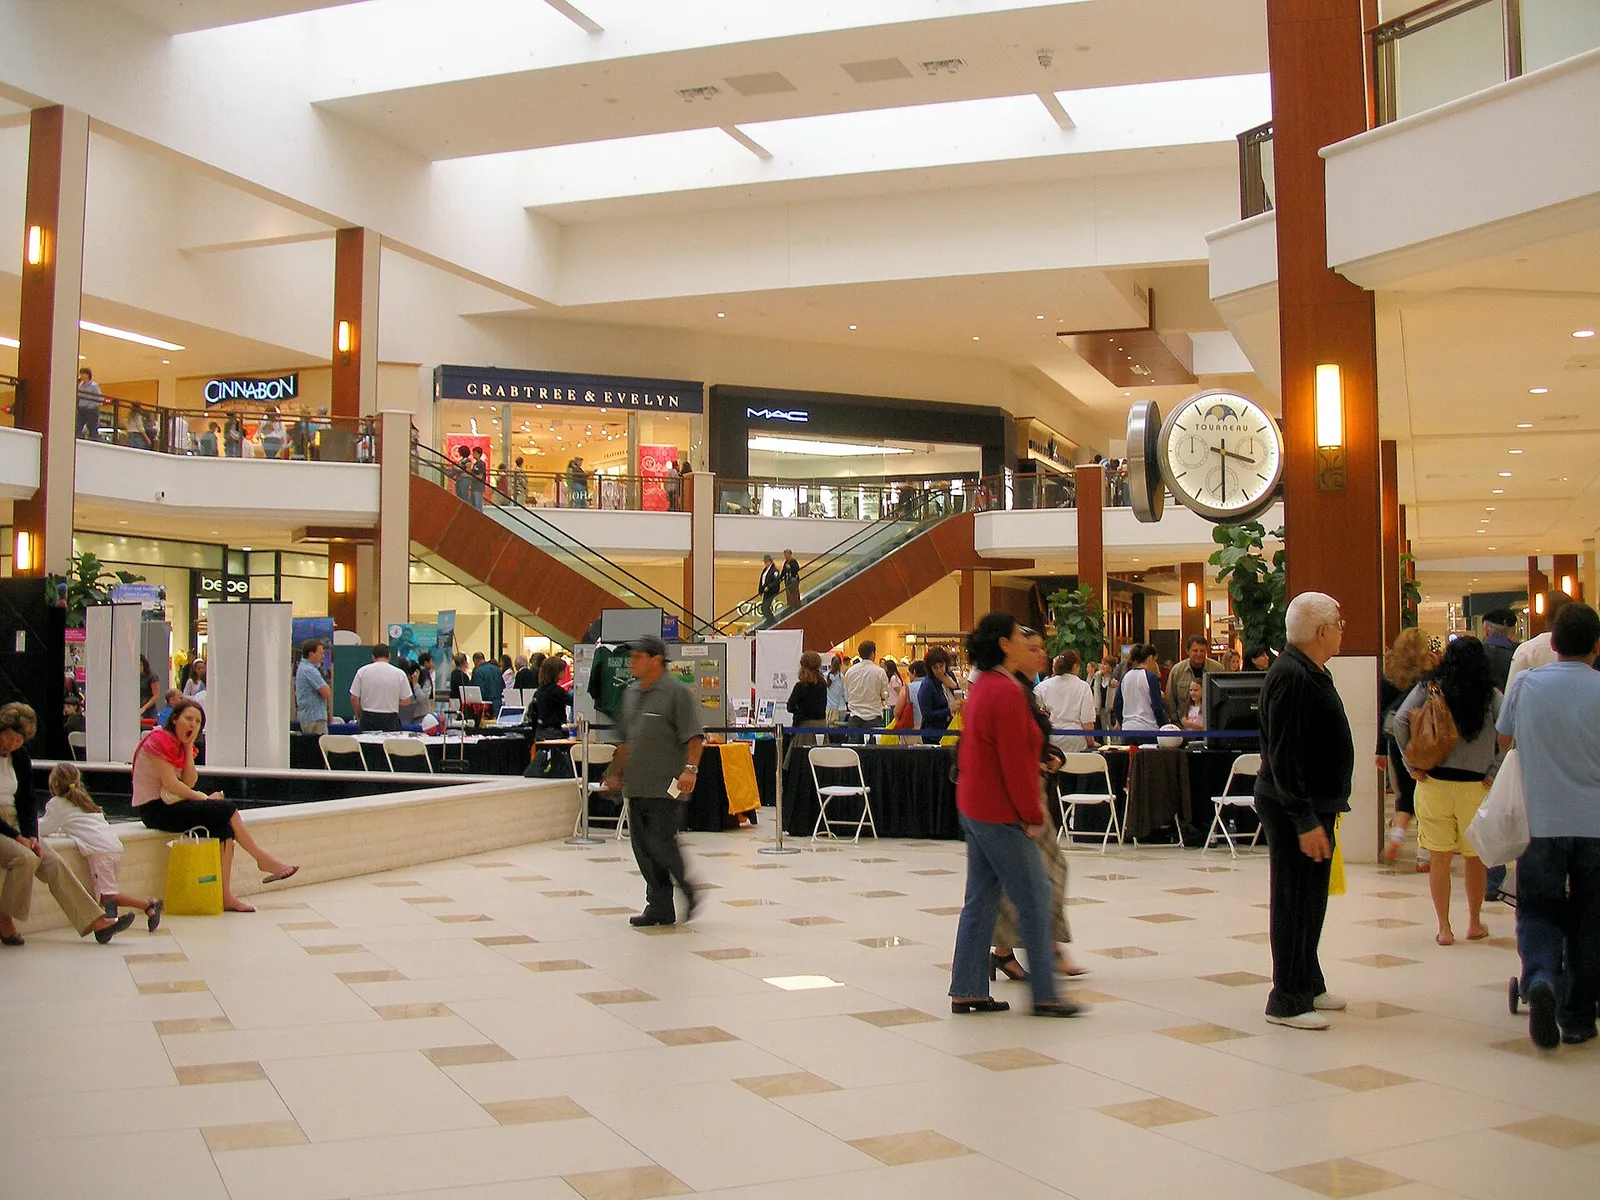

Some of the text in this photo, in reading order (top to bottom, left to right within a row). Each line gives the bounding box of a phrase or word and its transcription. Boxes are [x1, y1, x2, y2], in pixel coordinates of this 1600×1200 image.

[204, 375, 294, 403] CINNABON
[466, 383, 680, 408] CRABTREE & EVELYN
[746, 407, 808, 422] MAC
[1194, 423, 1249, 432] TOURNEAU
[201, 576, 249, 593] bebe
